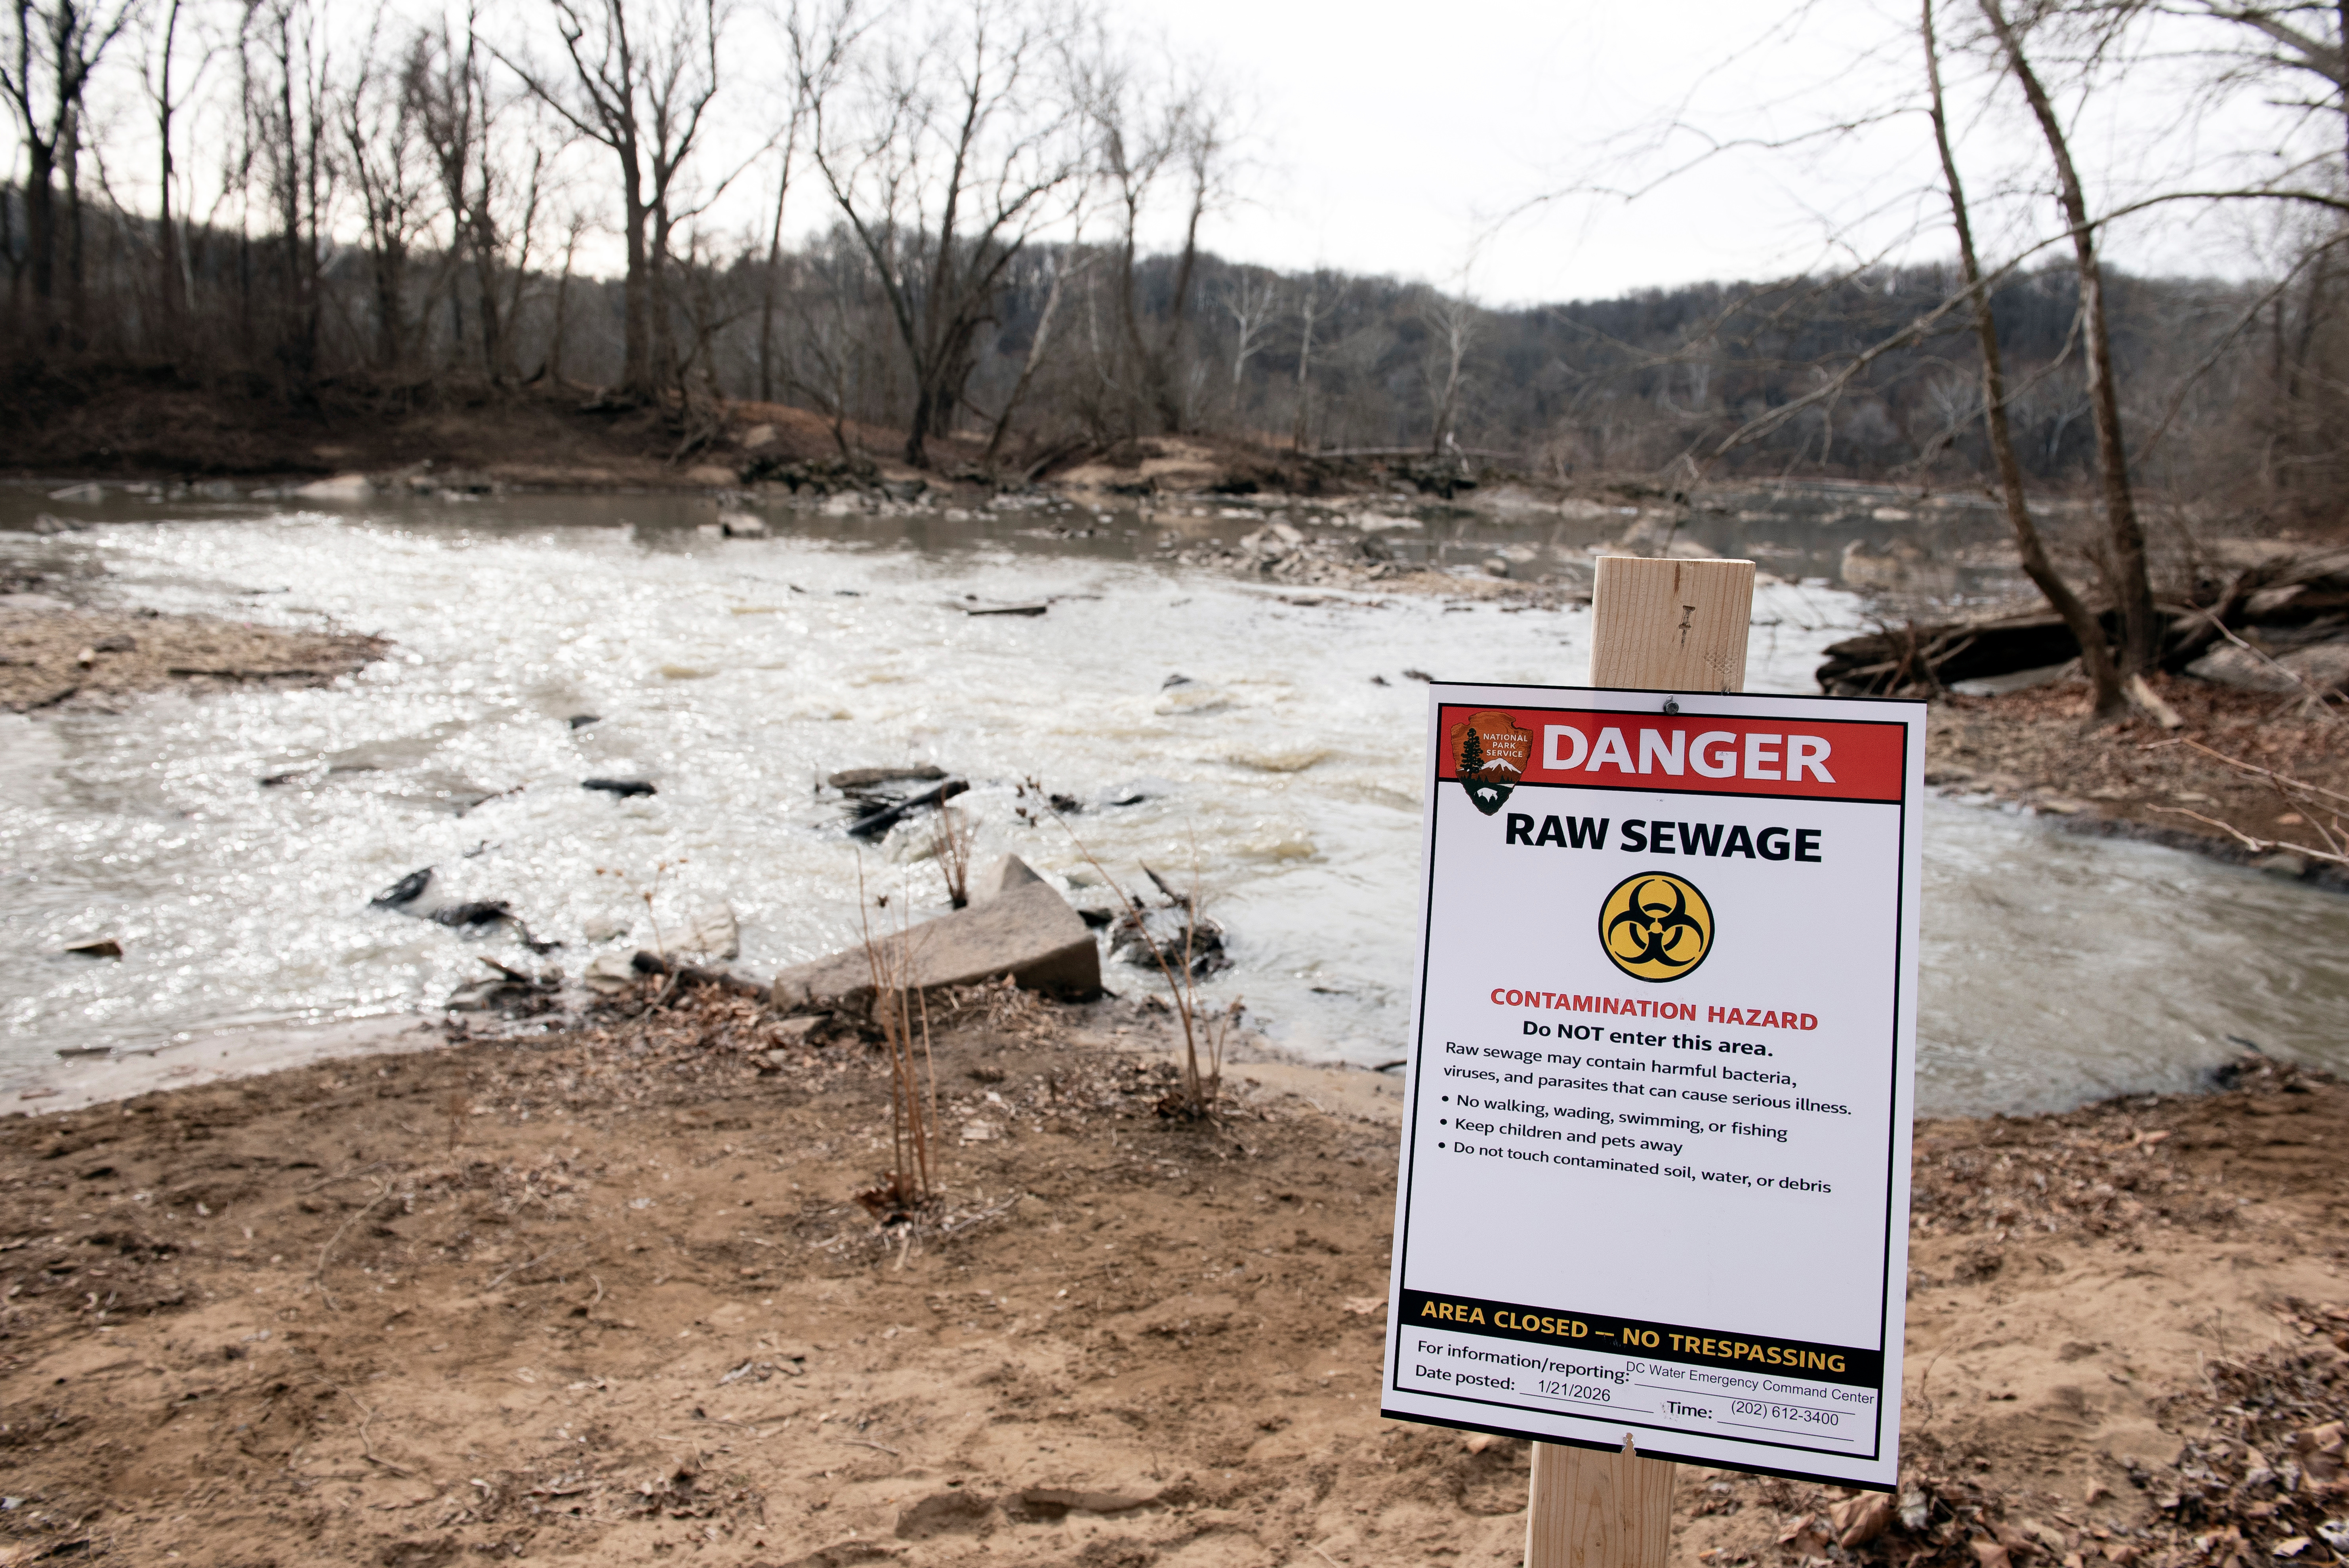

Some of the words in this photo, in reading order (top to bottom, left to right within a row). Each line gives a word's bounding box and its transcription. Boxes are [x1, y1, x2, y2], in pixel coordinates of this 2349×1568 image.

[1543, 725, 1836, 783] DANGER
[1506, 813, 1609, 850] RAW
[1621, 819, 1821, 862] SEWAGE
[1491, 989, 1696, 1021] CONTAMINATION
[1708, 1006, 1817, 1030] HAZARD
[1523, 1021, 1550, 1036] Do
[1558, 1024, 1604, 1041] NOT
[1610, 1032, 1666, 1046] enter
[1672, 1034, 1712, 1051] this
[1718, 1042, 1773, 1056] area.
[1446, 1042, 1479, 1055] Raw
[1483, 1048, 1542, 1064] sewage
[1548, 1054, 1581, 1069] may
[1586, 1058, 1645, 1071] contain
[1652, 1060, 1716, 1078] harmful
[1723, 1067, 1796, 1088] bacteria,
[1444, 1065, 1499, 1083] viruses,
[1504, 1073, 1533, 1084] and
[1539, 1077, 1608, 1091] parasites
[1612, 1081, 1644, 1095] that
[1649, 1088, 1676, 1098] can
[1682, 1091, 1727, 1103] cause
[1733, 1094, 1790, 1109] serious
[1796, 1098, 1851, 1115] illness.
[1456, 1118, 1494, 1136] Keep
[1499, 1123, 1561, 1140] children
[1567, 1132, 1596, 1143] and
[1602, 1136, 1635, 1148] pets
[1640, 1141, 1683, 1156] away
[1457, 1095, 1479, 1107] No
[1484, 1099, 1548, 1118] walking,
[1554, 1107, 1614, 1124] wading,
[1619, 1113, 1703, 1134] swimming,
[1709, 1123, 1726, 1132] or
[1731, 1122, 1787, 1142] fishing
[1455, 1142, 1474, 1154] Do
[1480, 1147, 1503, 1157] not
[1507, 1149, 1548, 1162] touch
[1554, 1156, 1659, 1174] contaminated
[1664, 1166, 1695, 1181] soil,
[1701, 1172, 1751, 1187] water,
[1757, 1177, 1774, 1187] or
[1779, 1177, 1831, 1193] debris
[1421, 1301, 1485, 1324] AREA
[1495, 1311, 1588, 1337] CLOSED
[1623, 1328, 1659, 1347] NO
[1669, 1334, 1845, 1372] TRESPASSING
[1416, 1365, 1451, 1380] Date
[1456, 1374, 1514, 1390] posted:
[1539, 1380, 1610, 1401] 1/21/2026
[1667, 1401, 1712, 1419] Time:
[1732, 1400, 1767, 1419] (202)
[1772, 1406, 1838, 1425] 612-3400
[1419, 1340, 1443, 1354] For
[1448, 1344, 1629, 1384] information/reporting:
[1626, 1361, 1645, 1373] DC
[1649, 1364, 1685, 1378] Water
[1690, 1370, 1758, 1391] Emergency
[1763, 1380, 1827, 1398] Command
[1832, 1389, 1874, 1404] Center
